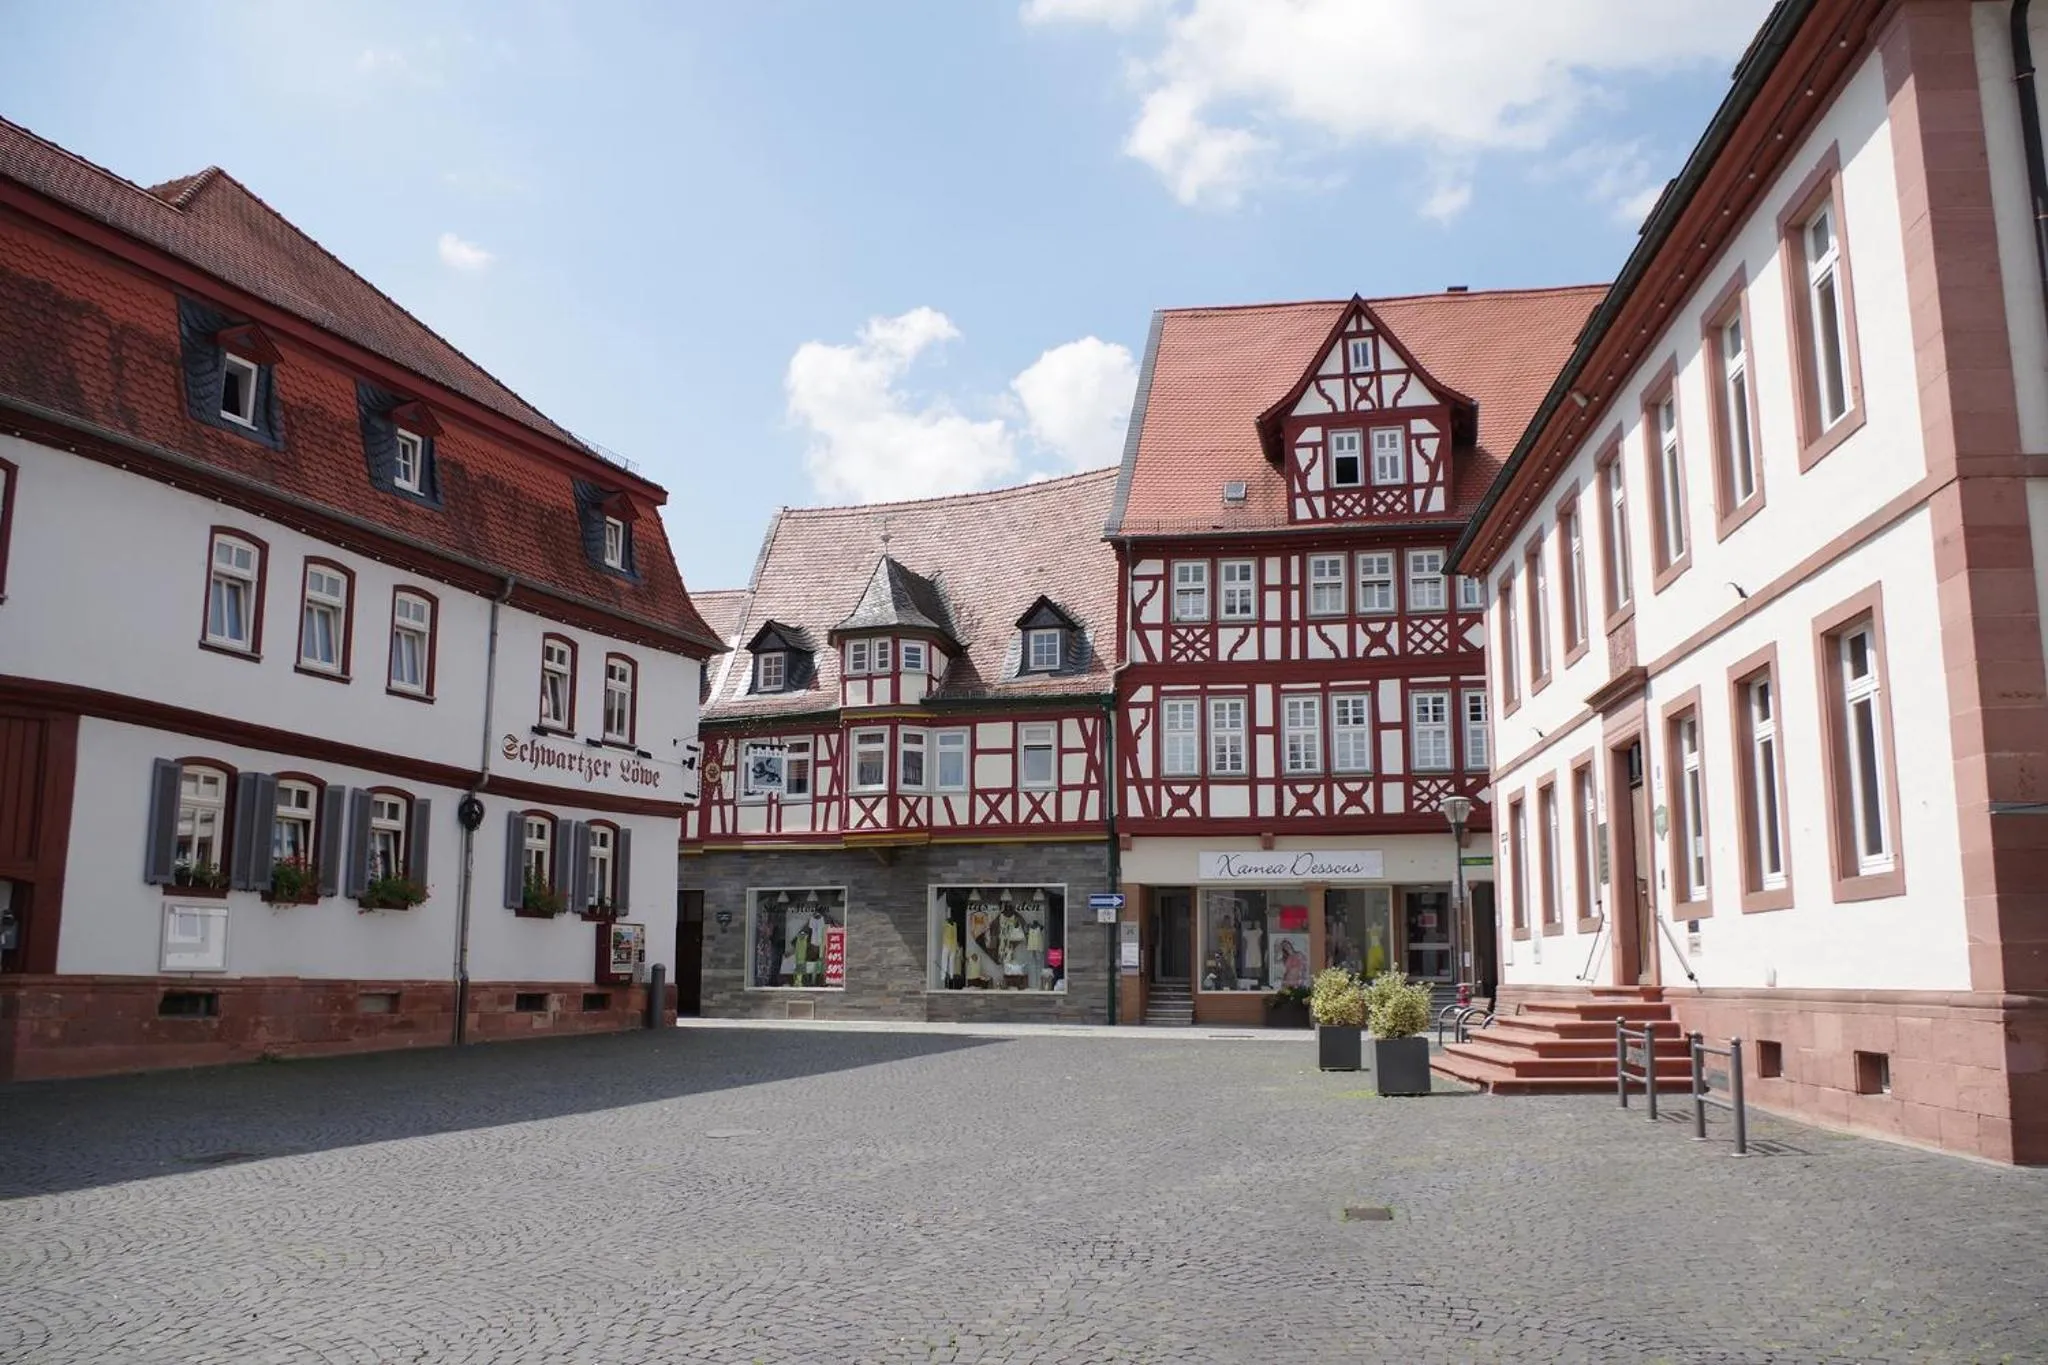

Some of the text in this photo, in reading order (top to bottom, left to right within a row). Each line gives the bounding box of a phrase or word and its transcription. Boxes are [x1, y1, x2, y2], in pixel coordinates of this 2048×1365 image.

[502, 733, 661, 788] Schwartzer Löwe
[1289, 851, 1364, 877] Dessous
